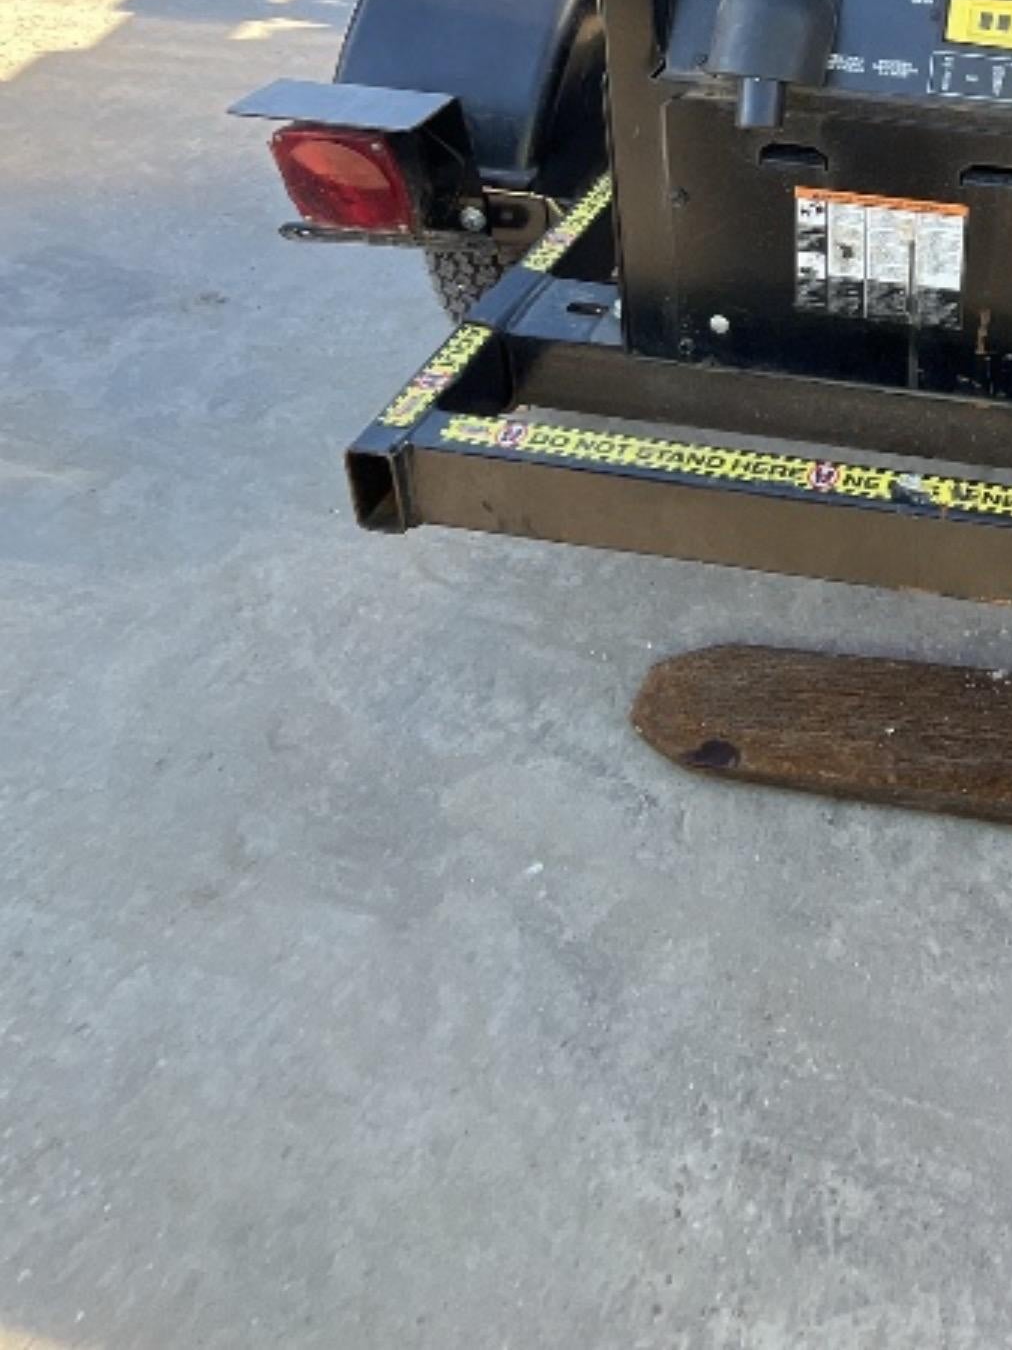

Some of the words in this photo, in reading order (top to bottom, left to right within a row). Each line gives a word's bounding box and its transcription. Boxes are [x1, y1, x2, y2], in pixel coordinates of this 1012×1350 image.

[527, 431, 571, 448] DO
[575, 436, 632, 454] NOT
[635, 445, 724, 469] STAND
[731, 457, 809, 479] HERE
